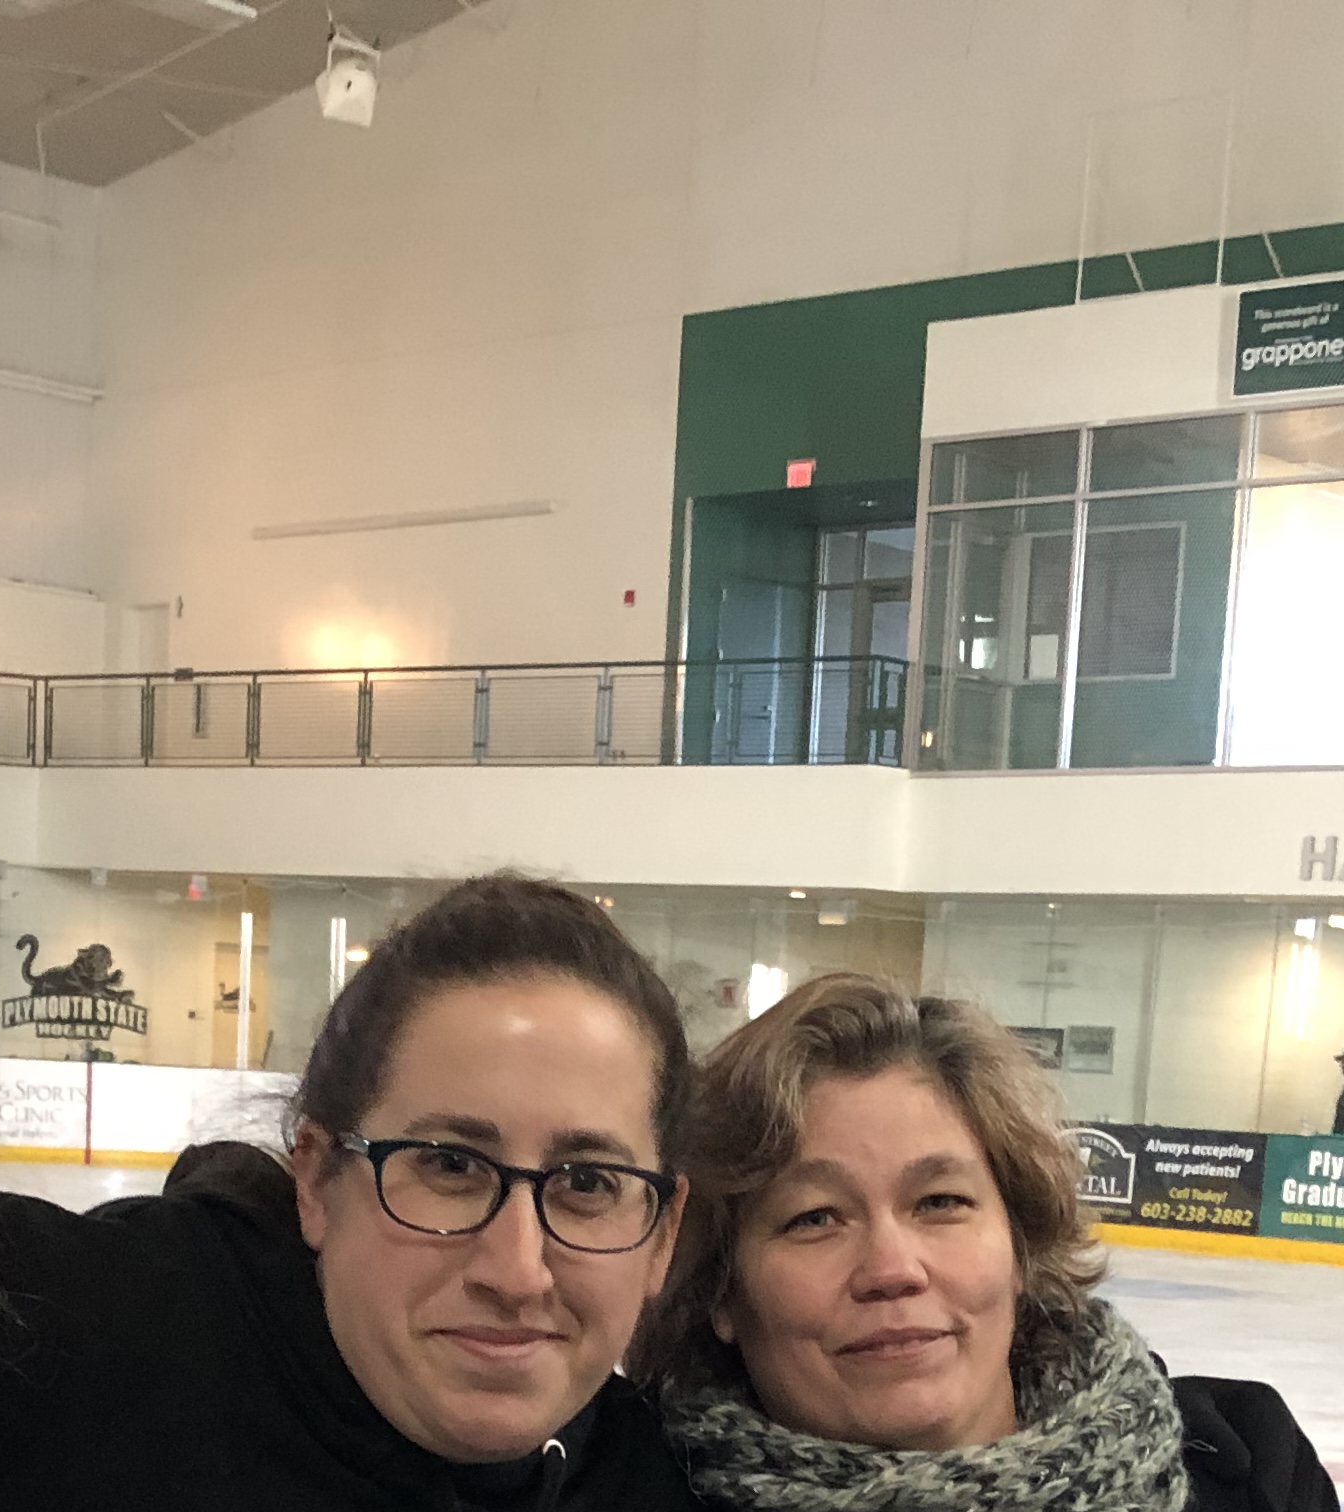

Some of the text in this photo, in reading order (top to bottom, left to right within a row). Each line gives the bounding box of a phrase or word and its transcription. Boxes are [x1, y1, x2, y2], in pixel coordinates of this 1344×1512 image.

[4, 996, 146, 1032] PLYMOUTH STATE
[1146, 1139, 1254, 1162] Always accepting
[1155, 1161, 1242, 1179] new patients!
[1169, 1186, 1228, 1205] Call Today!
[1141, 1202, 1254, 1227] 603-238-2882
